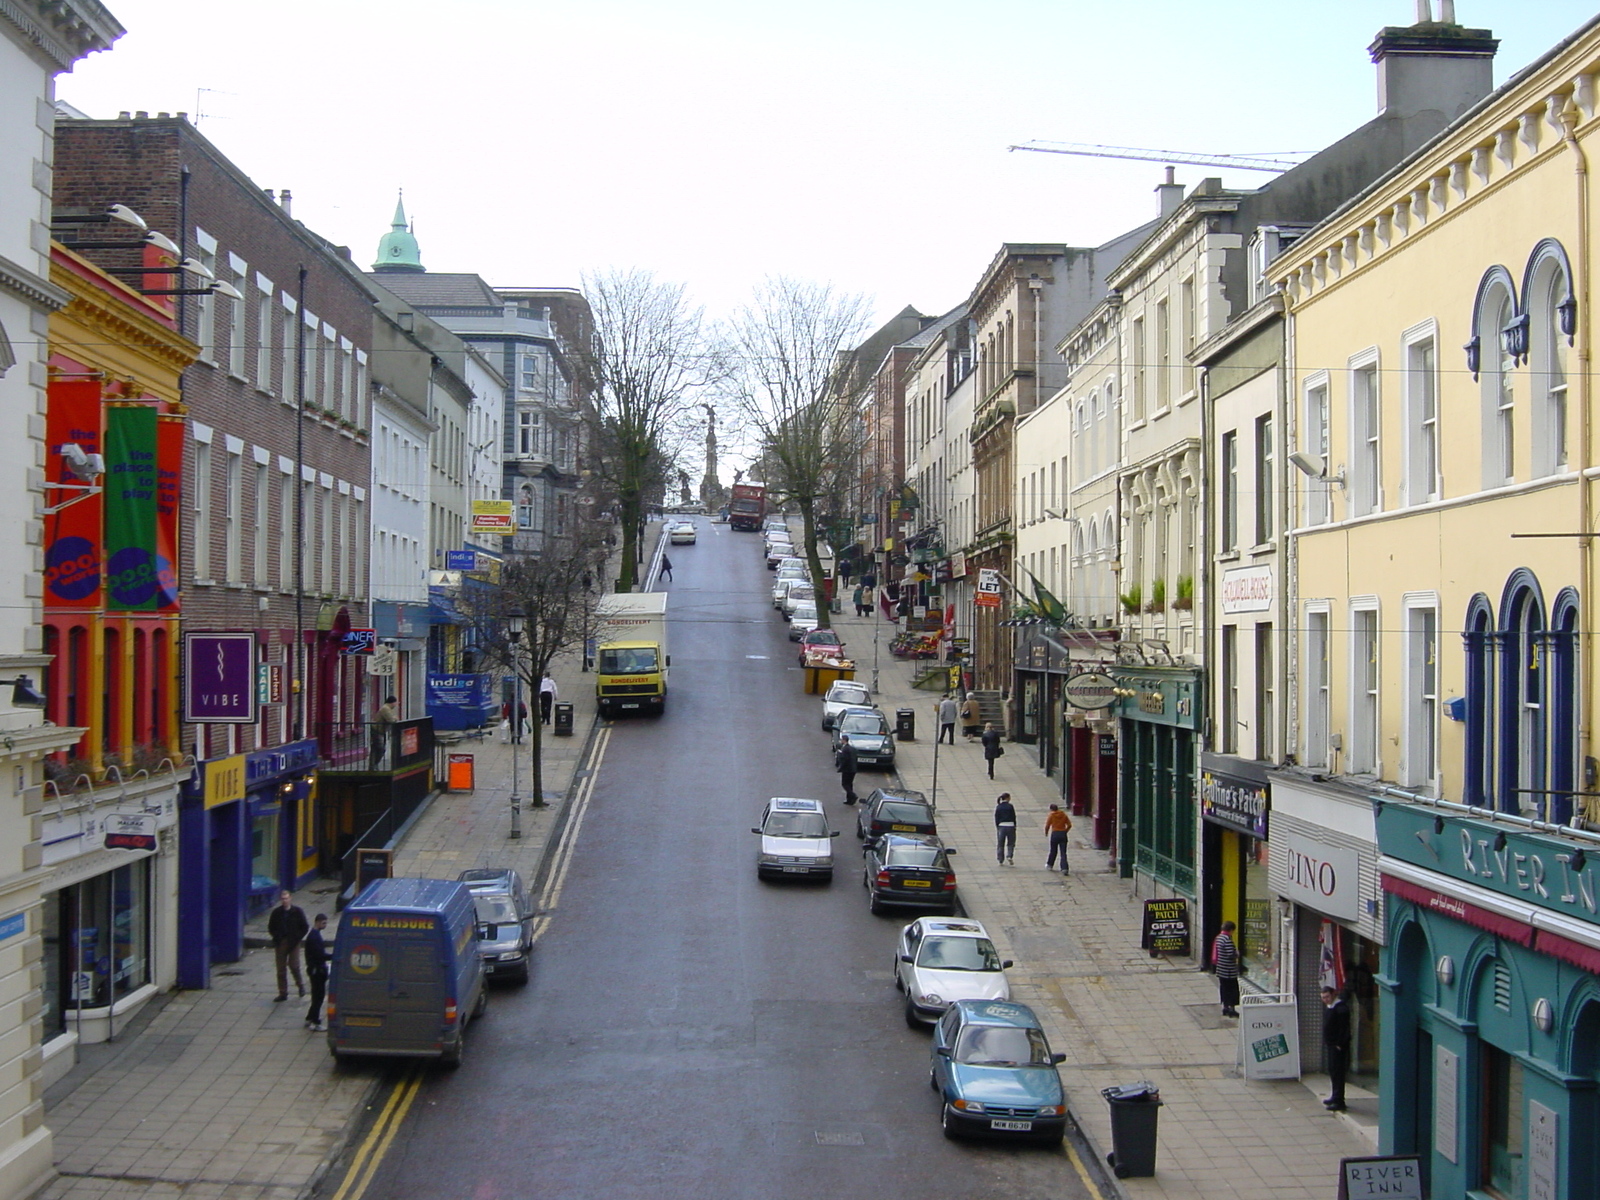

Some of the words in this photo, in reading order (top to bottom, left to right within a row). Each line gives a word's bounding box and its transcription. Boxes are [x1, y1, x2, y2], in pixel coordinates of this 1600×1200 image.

[130, 451, 153, 460] the
[113, 462, 153, 474] place
[979, 582, 999, 592] LET
[382, 664, 393, 673] 33
[430, 678, 475, 688] indigo
[202, 693, 240, 707] VIBE
[214, 767, 239, 800] VIBE
[1461, 828, 1549, 900] RIVER
[1288, 848, 1336, 897] GINO
[1147, 902, 1185, 911] PAULINE'S
[1155, 910, 1179, 919] PATCH
[1151, 921, 1184, 930] GIFTS
[1259, 1047, 1286, 1061] FREE
[1351, 1165, 1415, 1180] RIVER
[1366, 1181, 1403, 1194] INN
